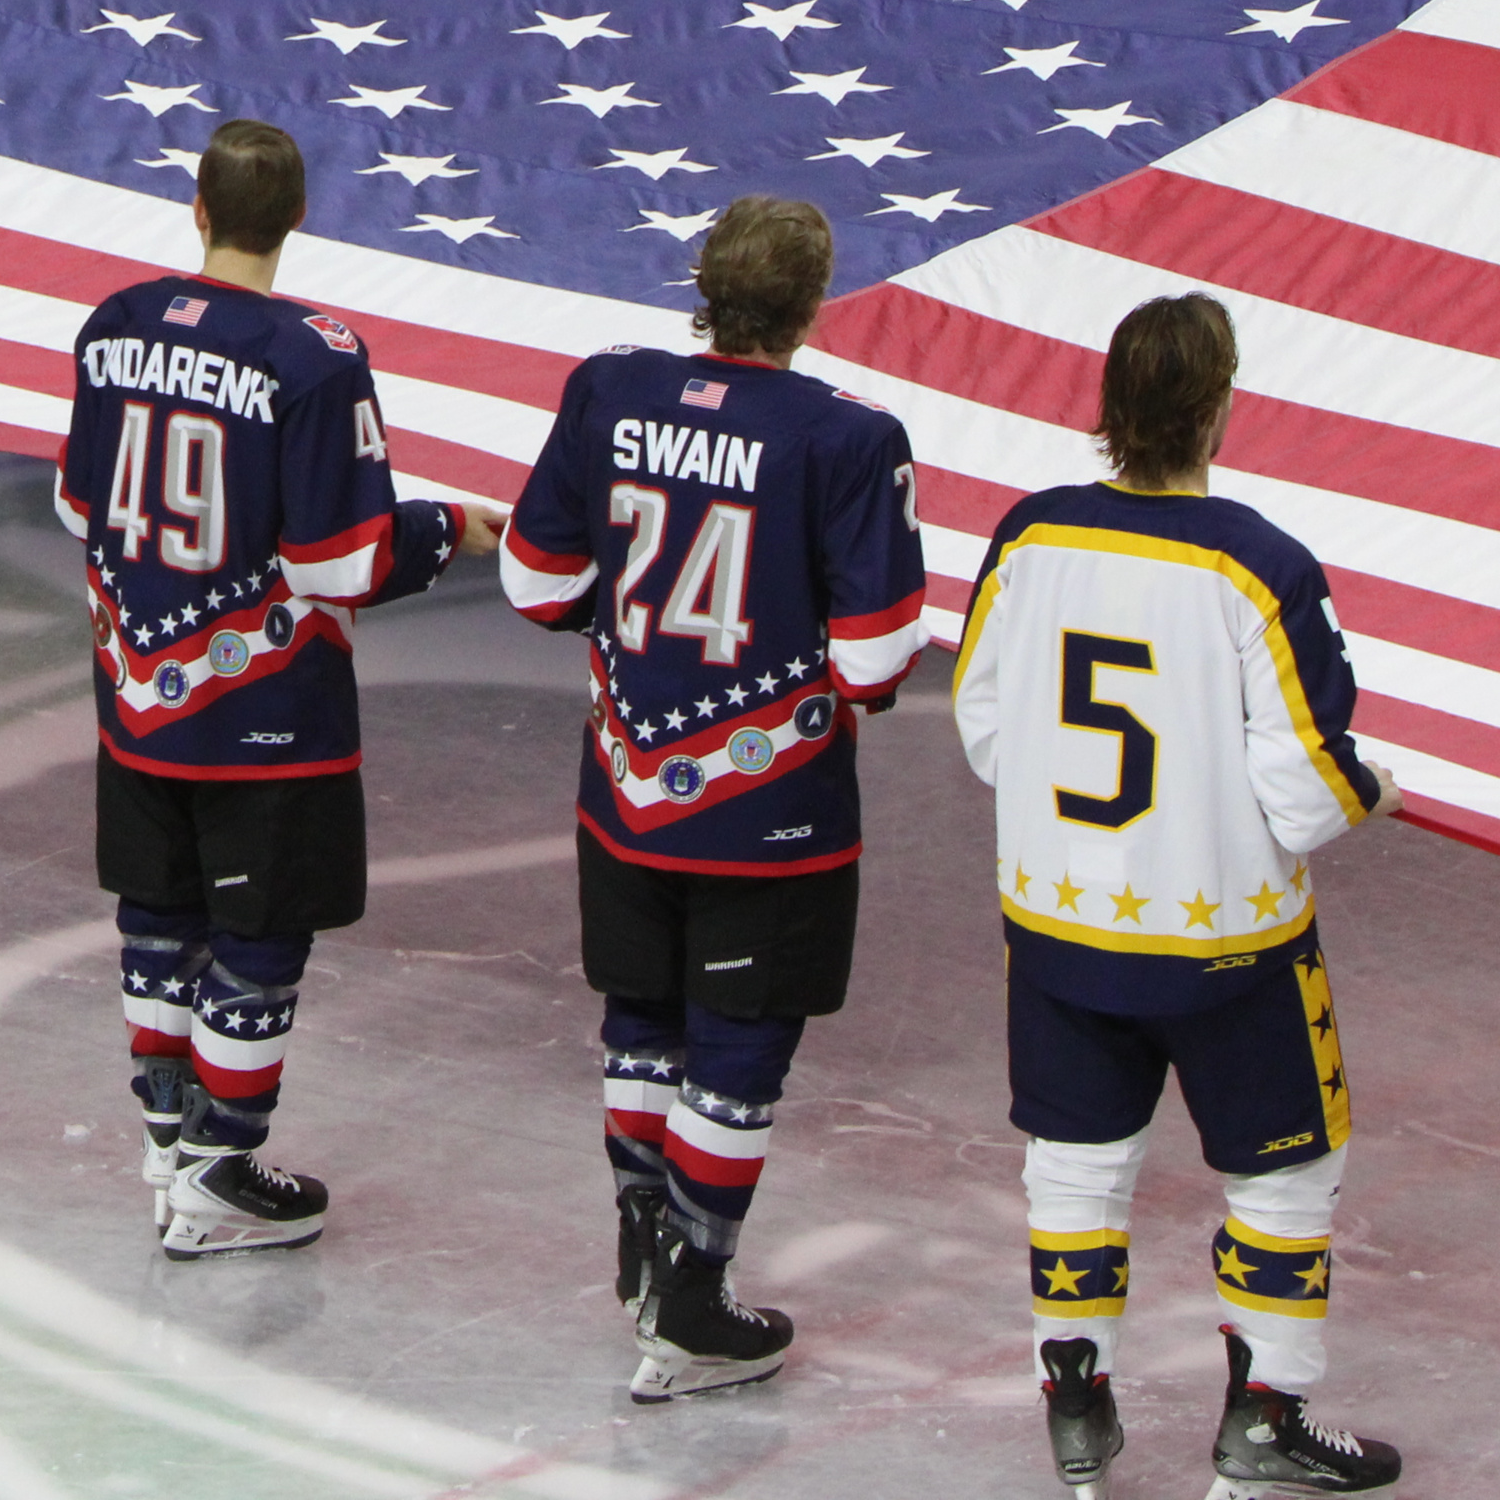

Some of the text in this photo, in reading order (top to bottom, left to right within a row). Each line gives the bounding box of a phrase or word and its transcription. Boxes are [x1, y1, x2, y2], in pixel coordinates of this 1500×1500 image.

[106, 402, 226, 574] 49
[612, 418, 763, 492] SWAIN
[608, 480, 757, 665] 24
[1052, 628, 1159, 832] 5
[215, 875, 248, 887] WARRIOR
[704, 957, 752, 971] WARRIOR
[238, 1189, 277, 1209] BAUER
